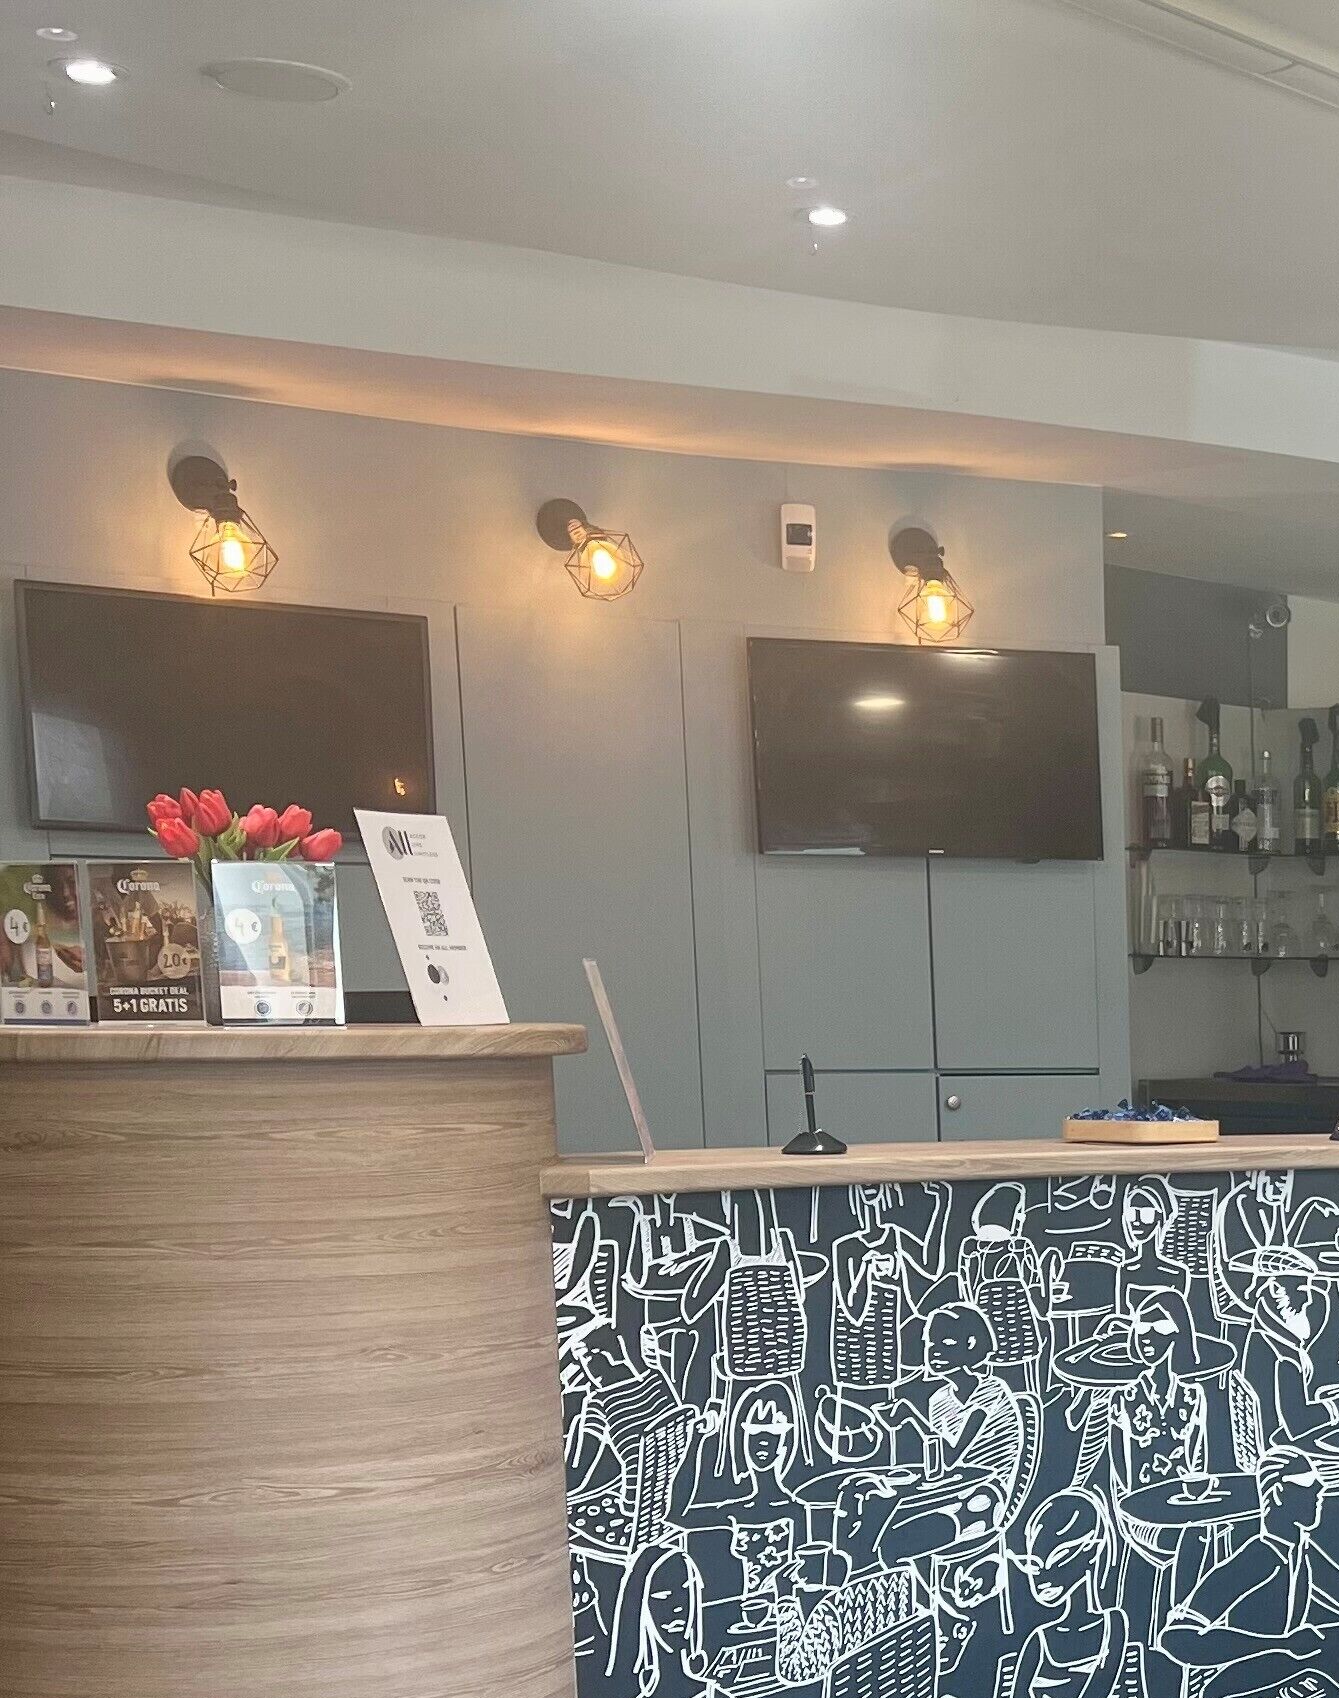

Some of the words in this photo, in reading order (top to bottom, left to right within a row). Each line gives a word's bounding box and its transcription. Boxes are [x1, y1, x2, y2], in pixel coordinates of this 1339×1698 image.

[116, 878, 161, 895] Corona
[169, 987, 190, 996] DEAL
[113, 998, 138, 1014] 5+1
[139, 998, 189, 1014] GRATIS
